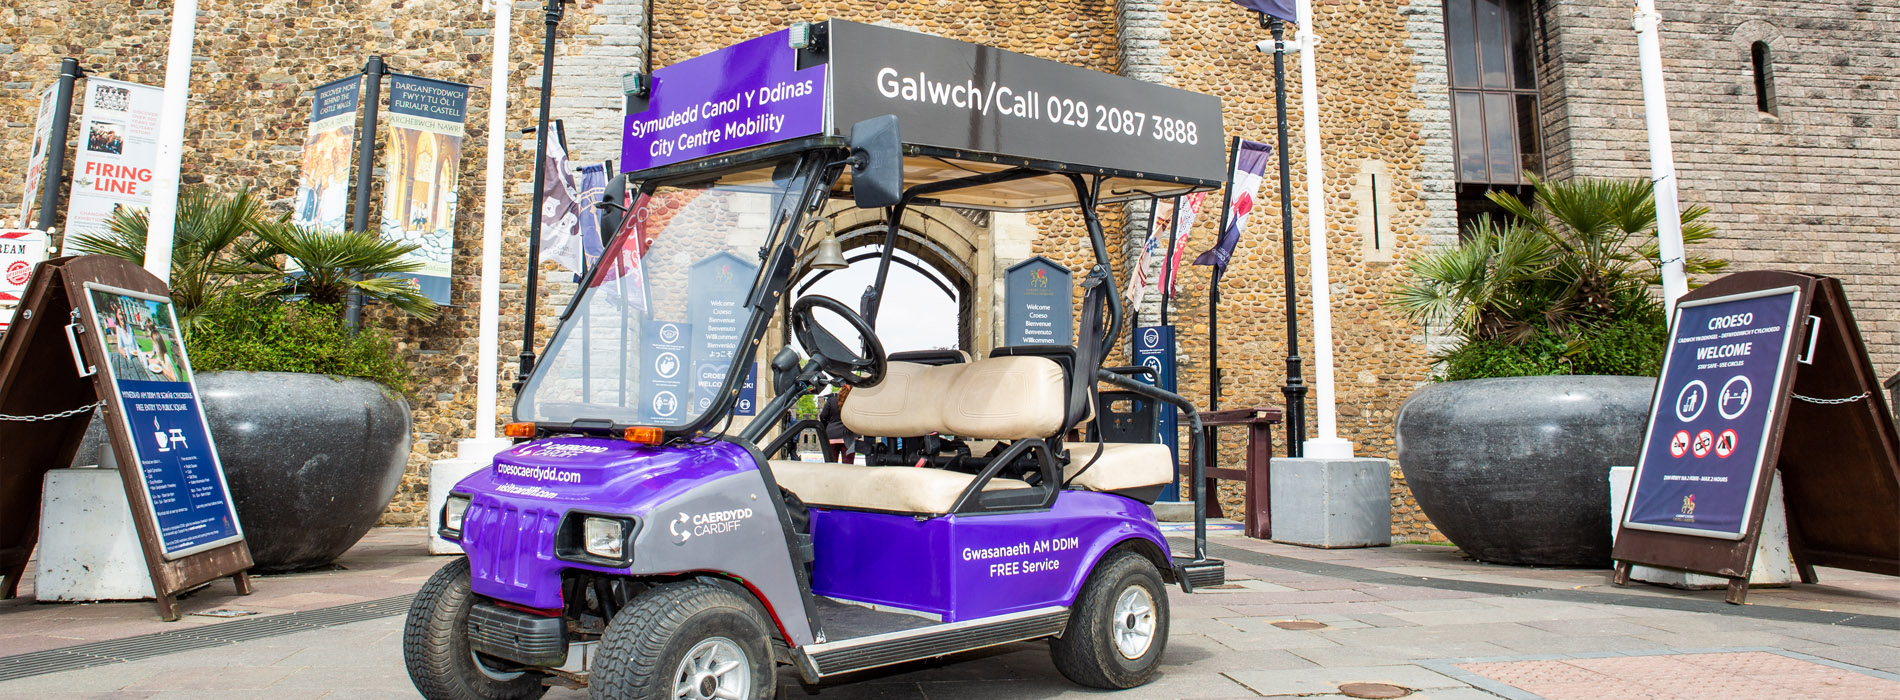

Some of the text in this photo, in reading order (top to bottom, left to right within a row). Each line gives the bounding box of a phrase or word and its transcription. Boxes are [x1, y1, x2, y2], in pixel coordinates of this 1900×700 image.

[320, 82, 357, 99] DISCOVER MORE
[323, 92, 350, 106] BEHIND THE
[395, 81, 464, 99] DARGANFYDDWCH
[320, 100, 351, 115] CASTLE WALLS
[395, 99, 461, 117] FURIAU'R CASTELL
[402, 92, 419, 101] FWY
[427, 95, 438, 104] TU
[440, 96, 450, 106] ÔL
[452, 99, 455, 107] I
[631, 78, 813, 138] Symudedd Canol Y Ddinas
[876, 66, 1198, 146] Galwch/Call 029 2087 3888
[390, 115, 435, 128] ARCHEBWCH
[650, 113, 785, 157] City Centre Mobility
[85, 160, 153, 182] FIRING
[94, 177, 137, 195] LINE
[1708, 312, 1754, 331] CROESO
[1696, 342, 1753, 360] WELCOME
[546, 443, 609, 453] CAERDYDD
[498, 463, 581, 484] croesocaerdydd.com
[495, 482, 558, 499] visitcardiff.com
[692, 508, 753, 525] CAERDYDD
[694, 520, 741, 537] CARDIFF
[962, 536, 1079, 561] Gwasanaeth AM DDIM
[989, 557, 1060, 577] FREE Service
